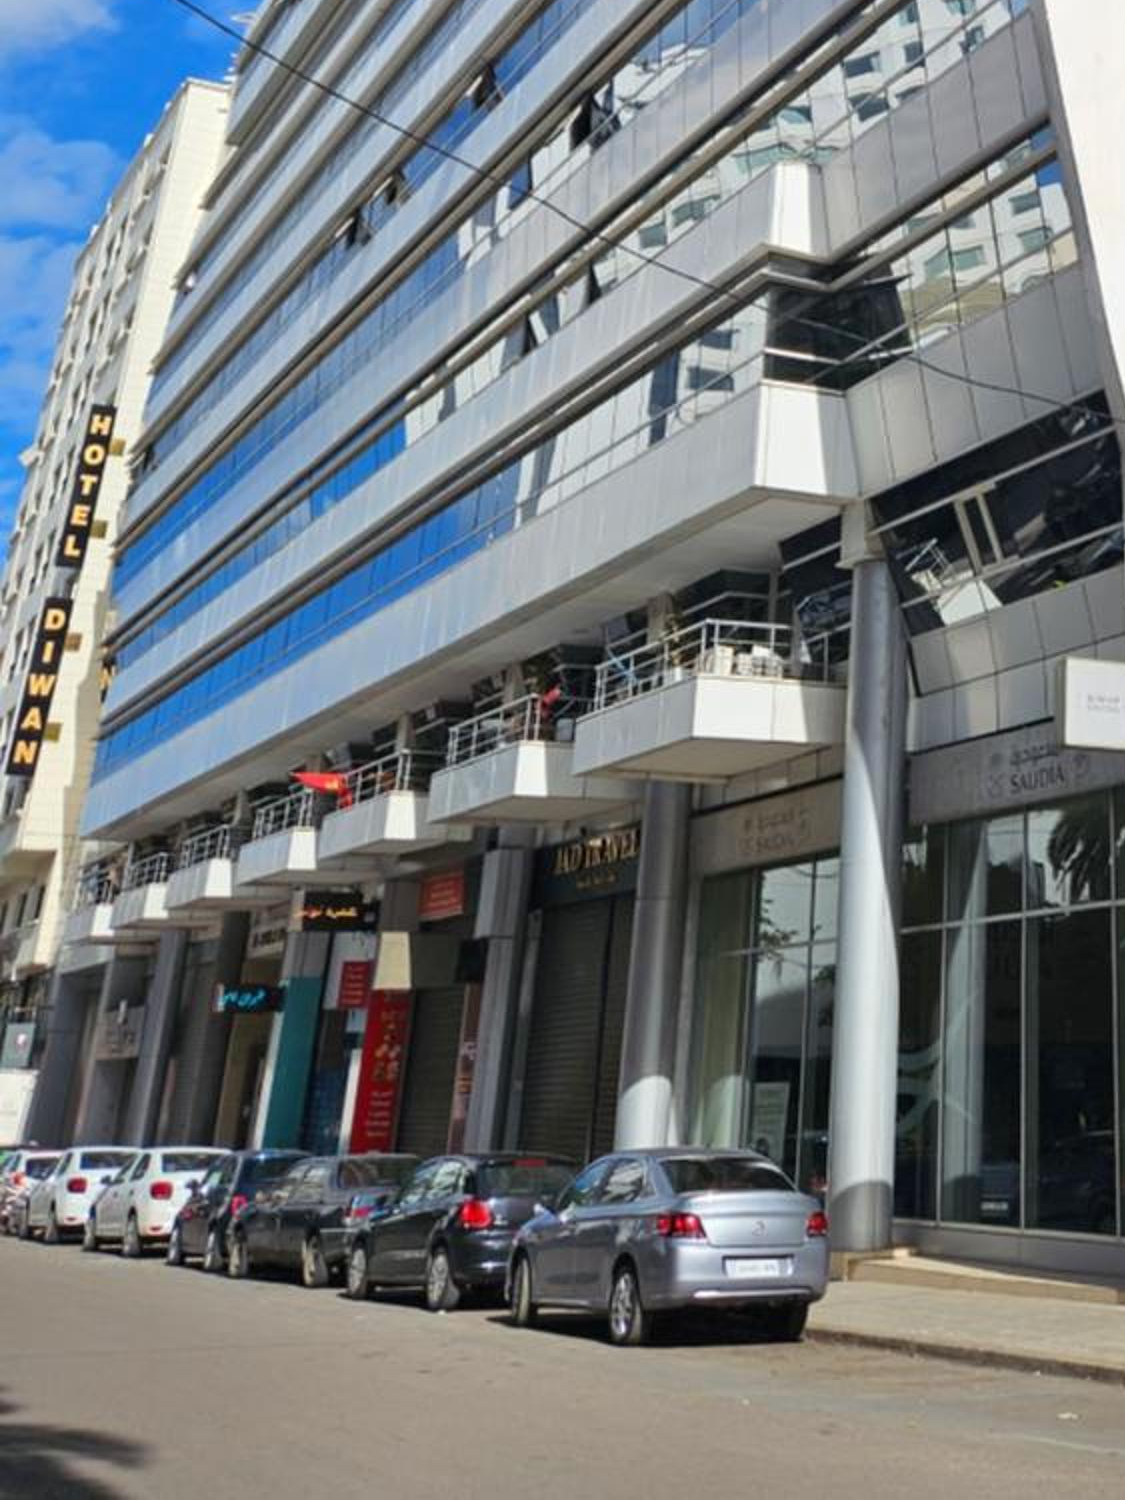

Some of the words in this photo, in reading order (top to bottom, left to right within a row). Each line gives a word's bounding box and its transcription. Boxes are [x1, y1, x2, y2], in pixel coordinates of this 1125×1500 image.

[63, 414, 112, 558] HOTEL
[12, 609, 67, 764] DIWAN
[1010, 765, 1065, 795] SAUDIA
